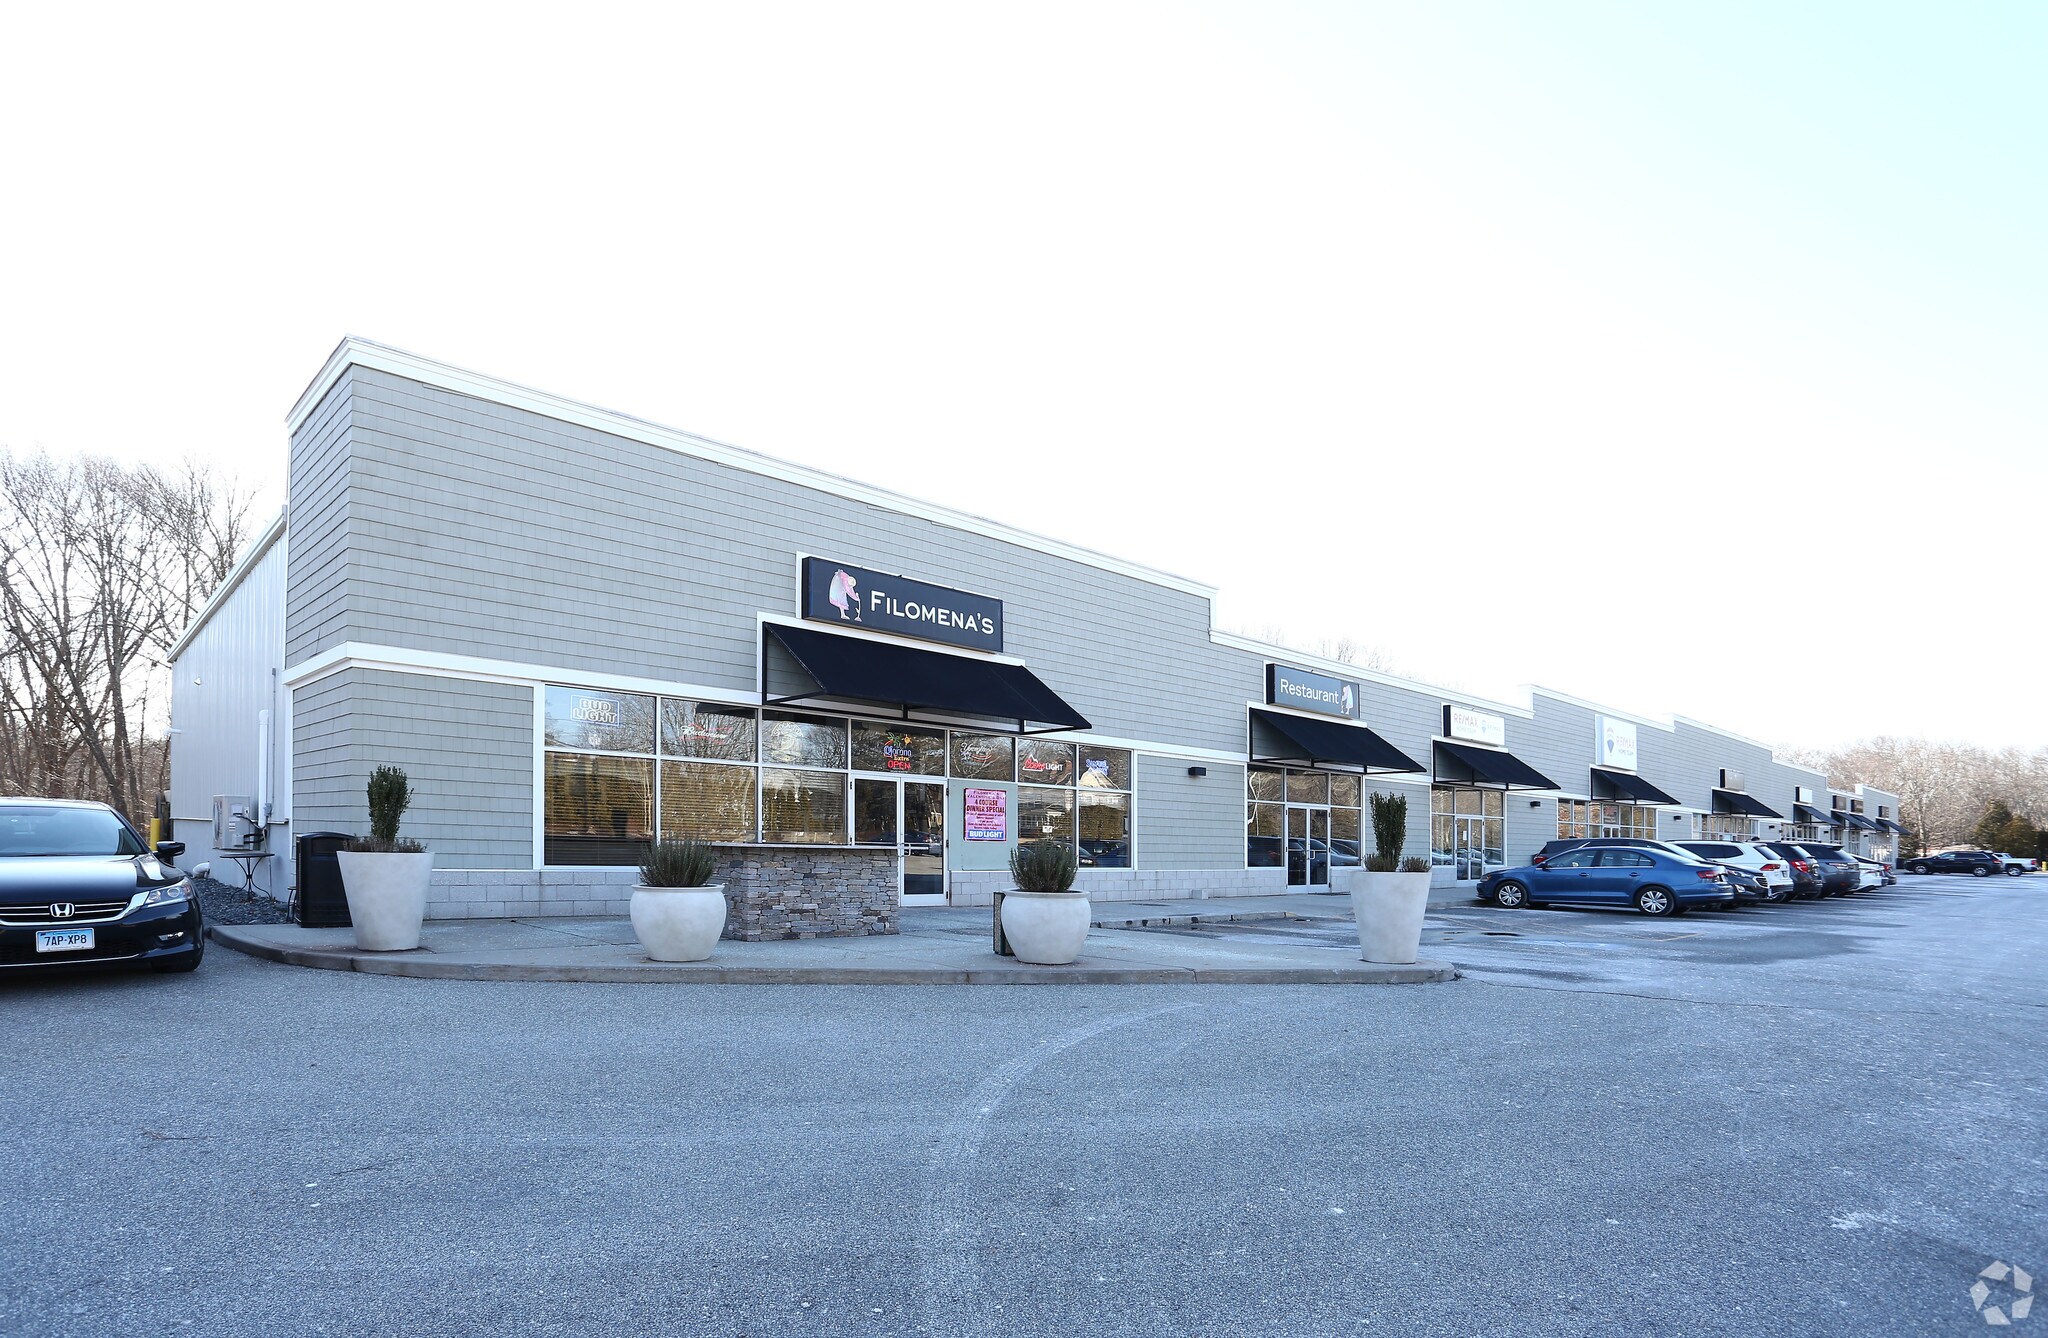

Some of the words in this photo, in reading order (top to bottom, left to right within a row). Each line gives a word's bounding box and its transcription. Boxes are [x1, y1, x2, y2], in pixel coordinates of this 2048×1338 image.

[870, 589, 995, 636] FILOMENA'S
[1280, 678, 1339, 705] Restaurant
[579, 698, 611, 711] BUD
[572, 707, 617, 724] LIGHT
[883, 745, 912, 757] Corona
[893, 754, 910, 762] Extra
[887, 760, 912, 770] OPEN
[1045, 762, 1064, 771] LIGHT
